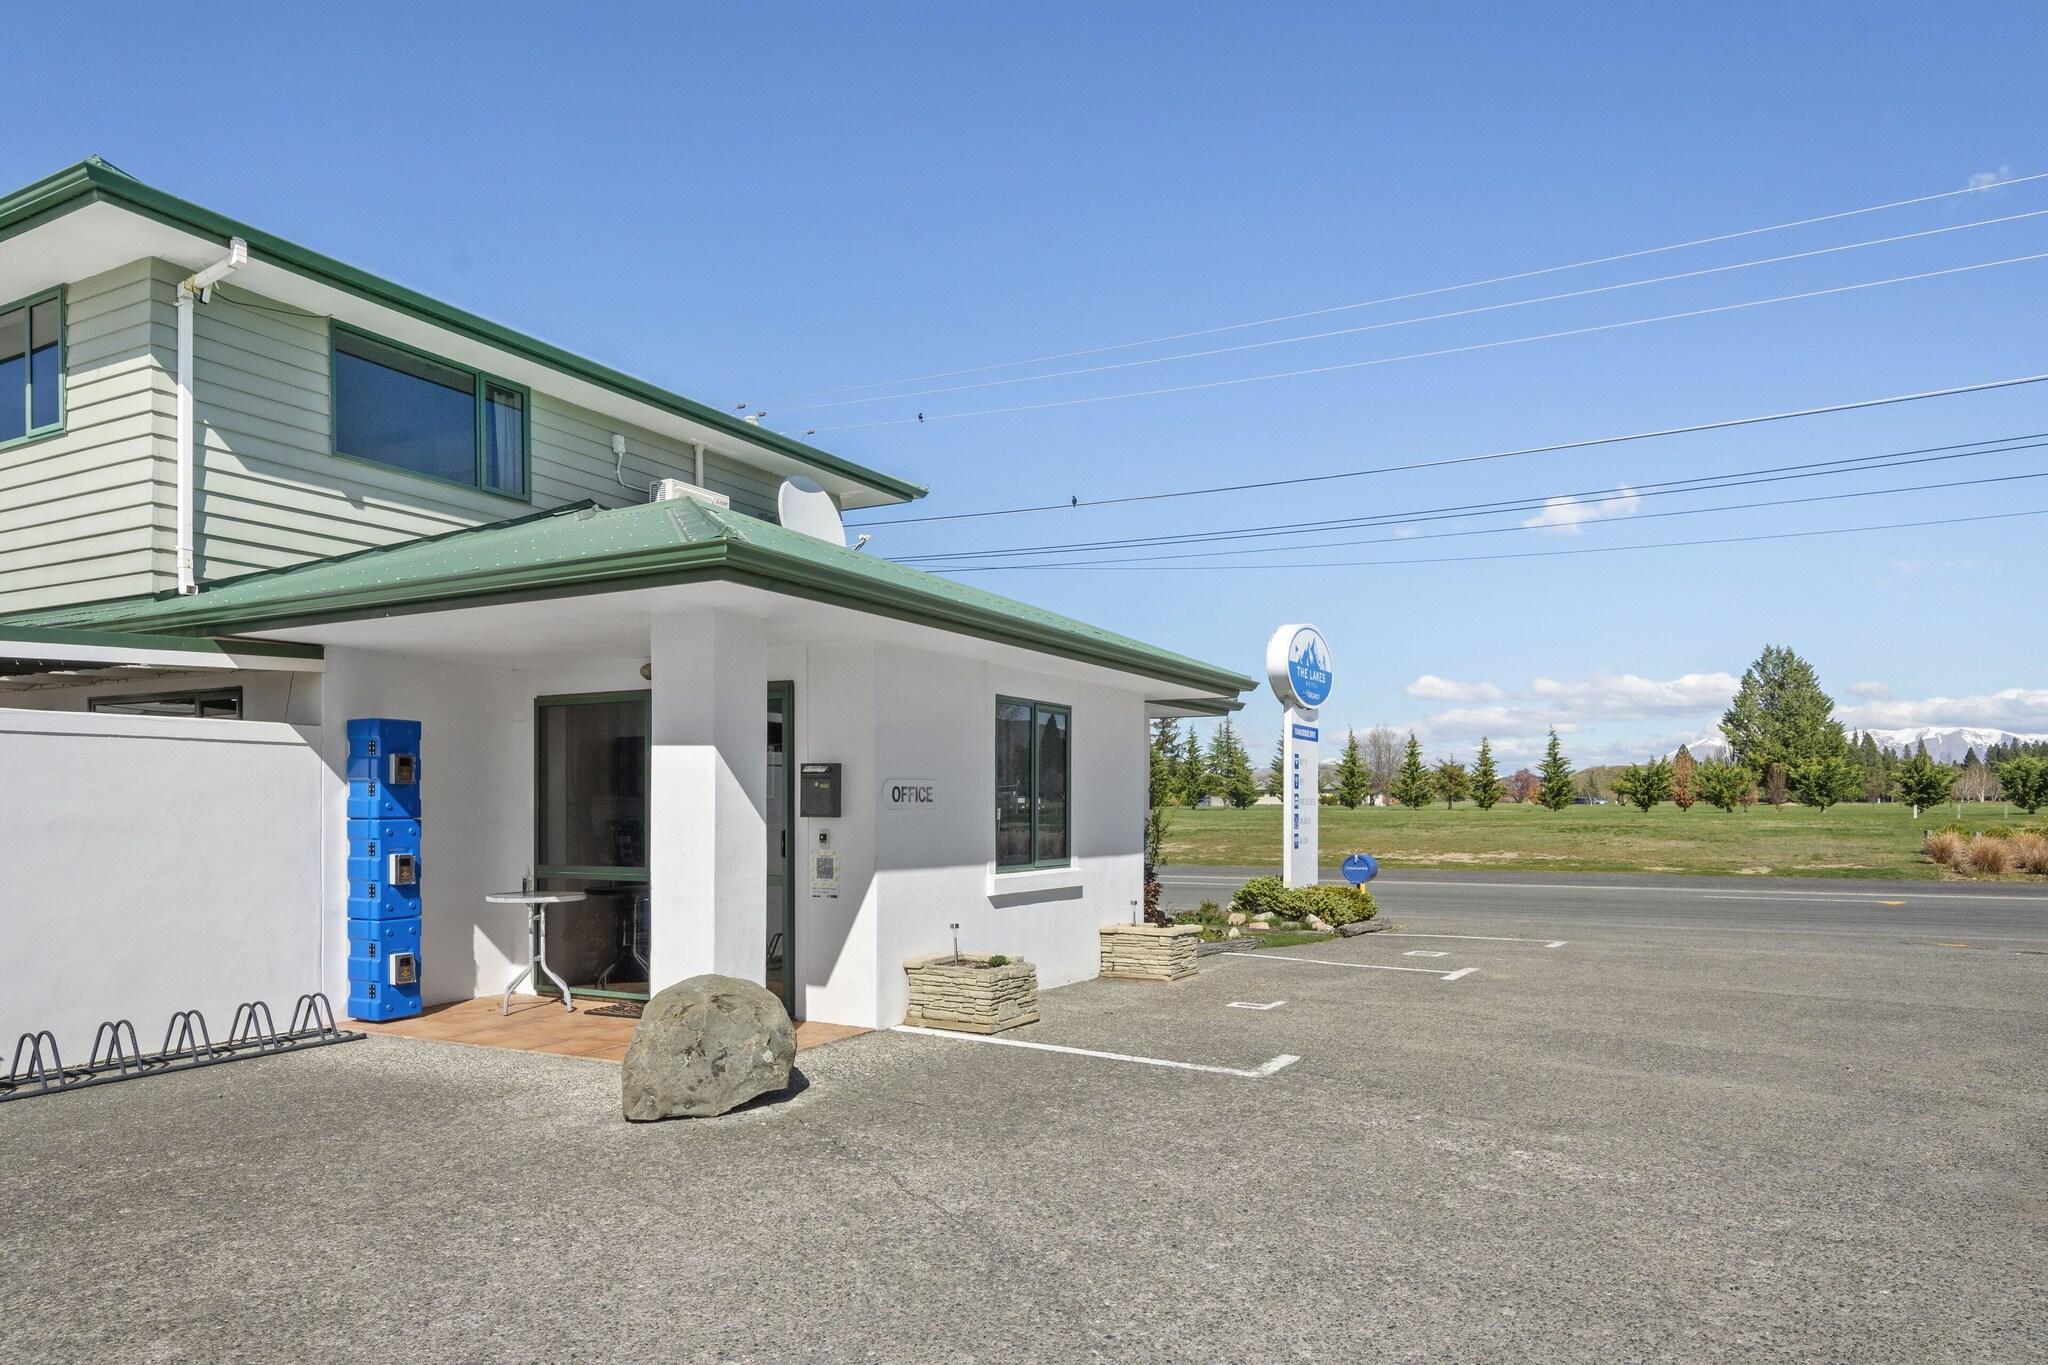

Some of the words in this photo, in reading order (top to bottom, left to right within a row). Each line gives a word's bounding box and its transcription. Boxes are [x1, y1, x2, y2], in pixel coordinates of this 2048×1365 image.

[1296, 665, 1308, 679] THE
[1309, 669, 1326, 684] LAKES
[892, 786, 933, 803] OFFICE
